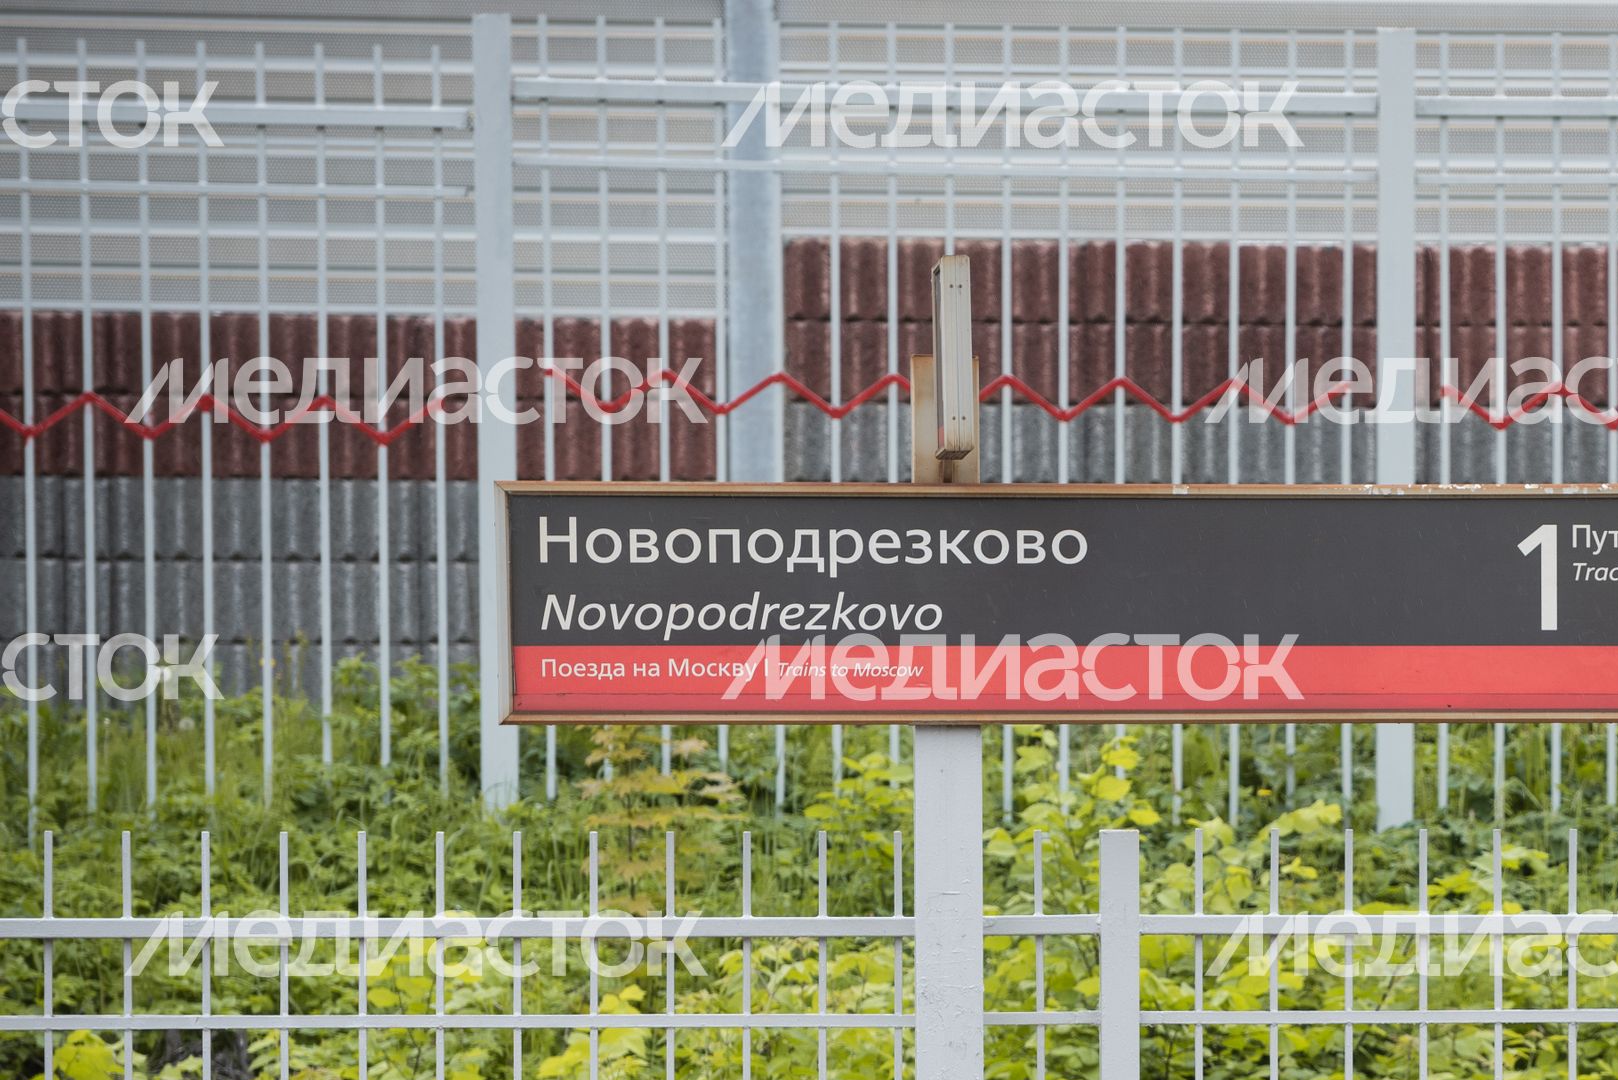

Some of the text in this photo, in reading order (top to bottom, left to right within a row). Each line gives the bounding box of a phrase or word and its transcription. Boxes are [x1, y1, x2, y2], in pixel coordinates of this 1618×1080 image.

[538, 516, 1088, 578] Новоподрезково
[1516, 524, 1558, 631] 1
[540, 592, 943, 641] Novopodrezkovo
[540, 658, 757, 682] Поезда на Москву
[778, 661, 924, 678] Trains to Moscow
